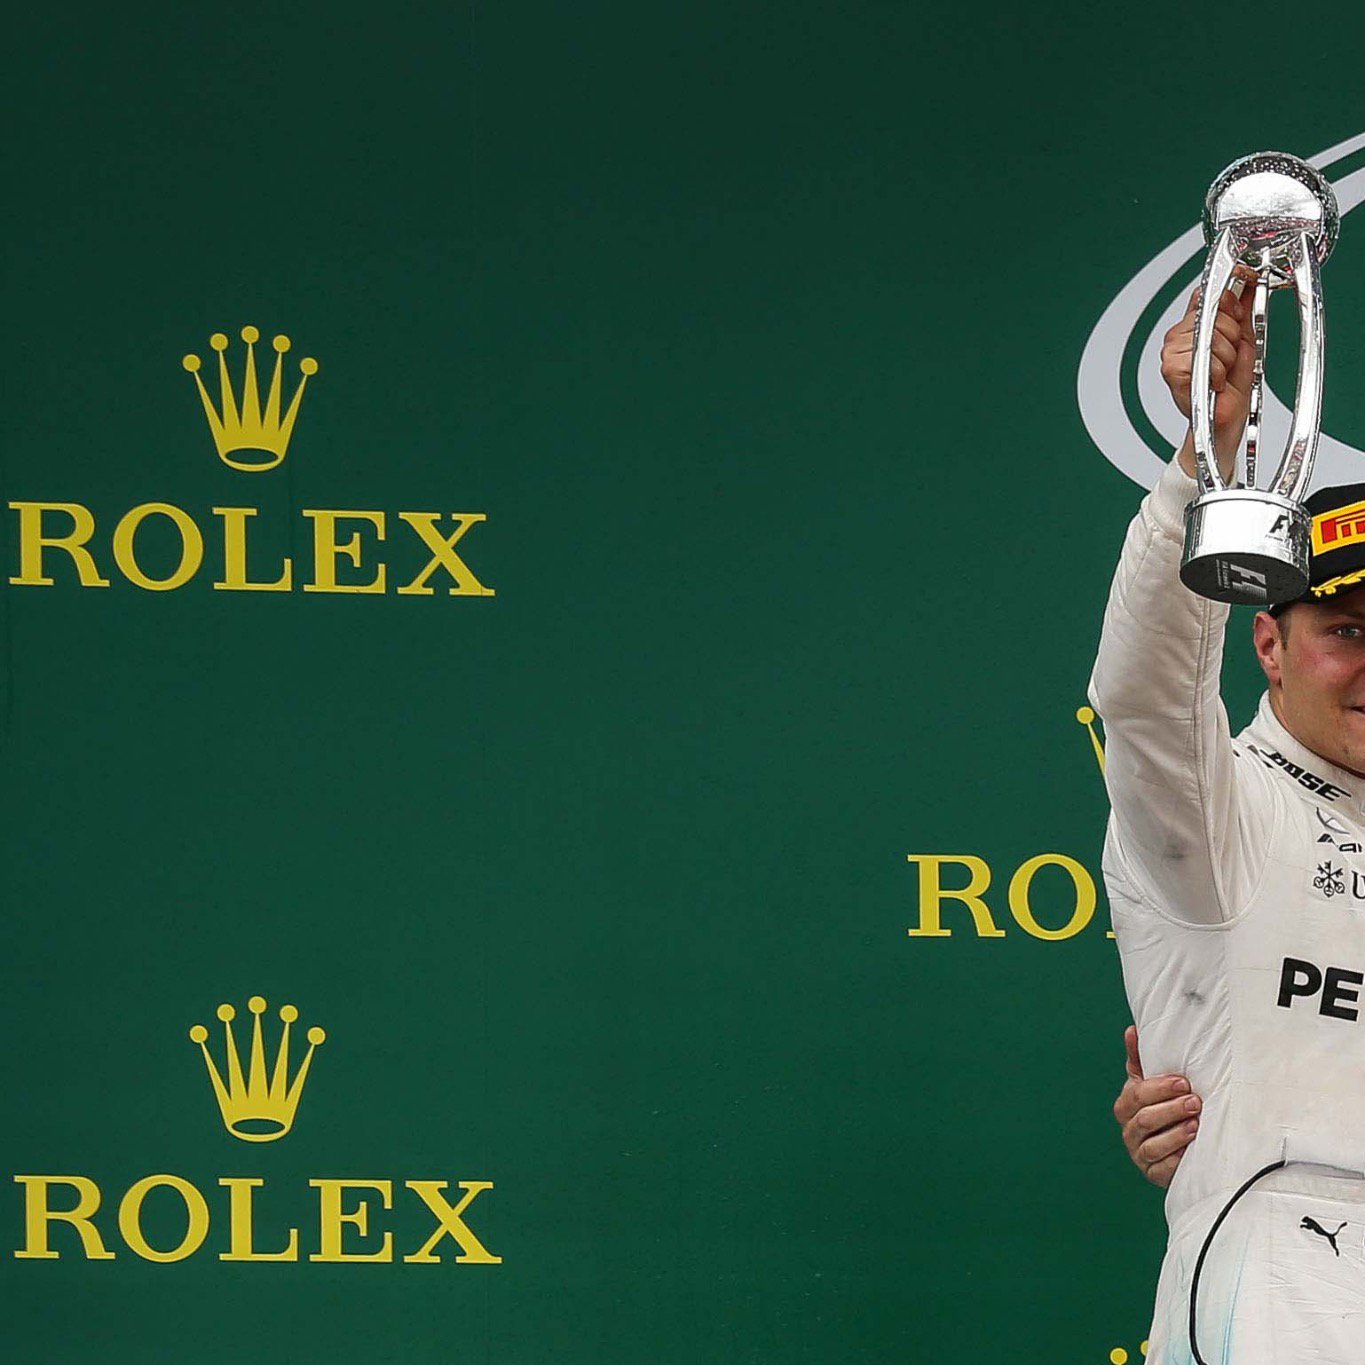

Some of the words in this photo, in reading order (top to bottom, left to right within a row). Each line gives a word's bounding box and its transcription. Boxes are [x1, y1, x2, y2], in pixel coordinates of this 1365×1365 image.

[8, 501, 496, 597] ROLEX
[908, 853, 1116, 941] RO
[13, 1174, 503, 1265] ROLEX
